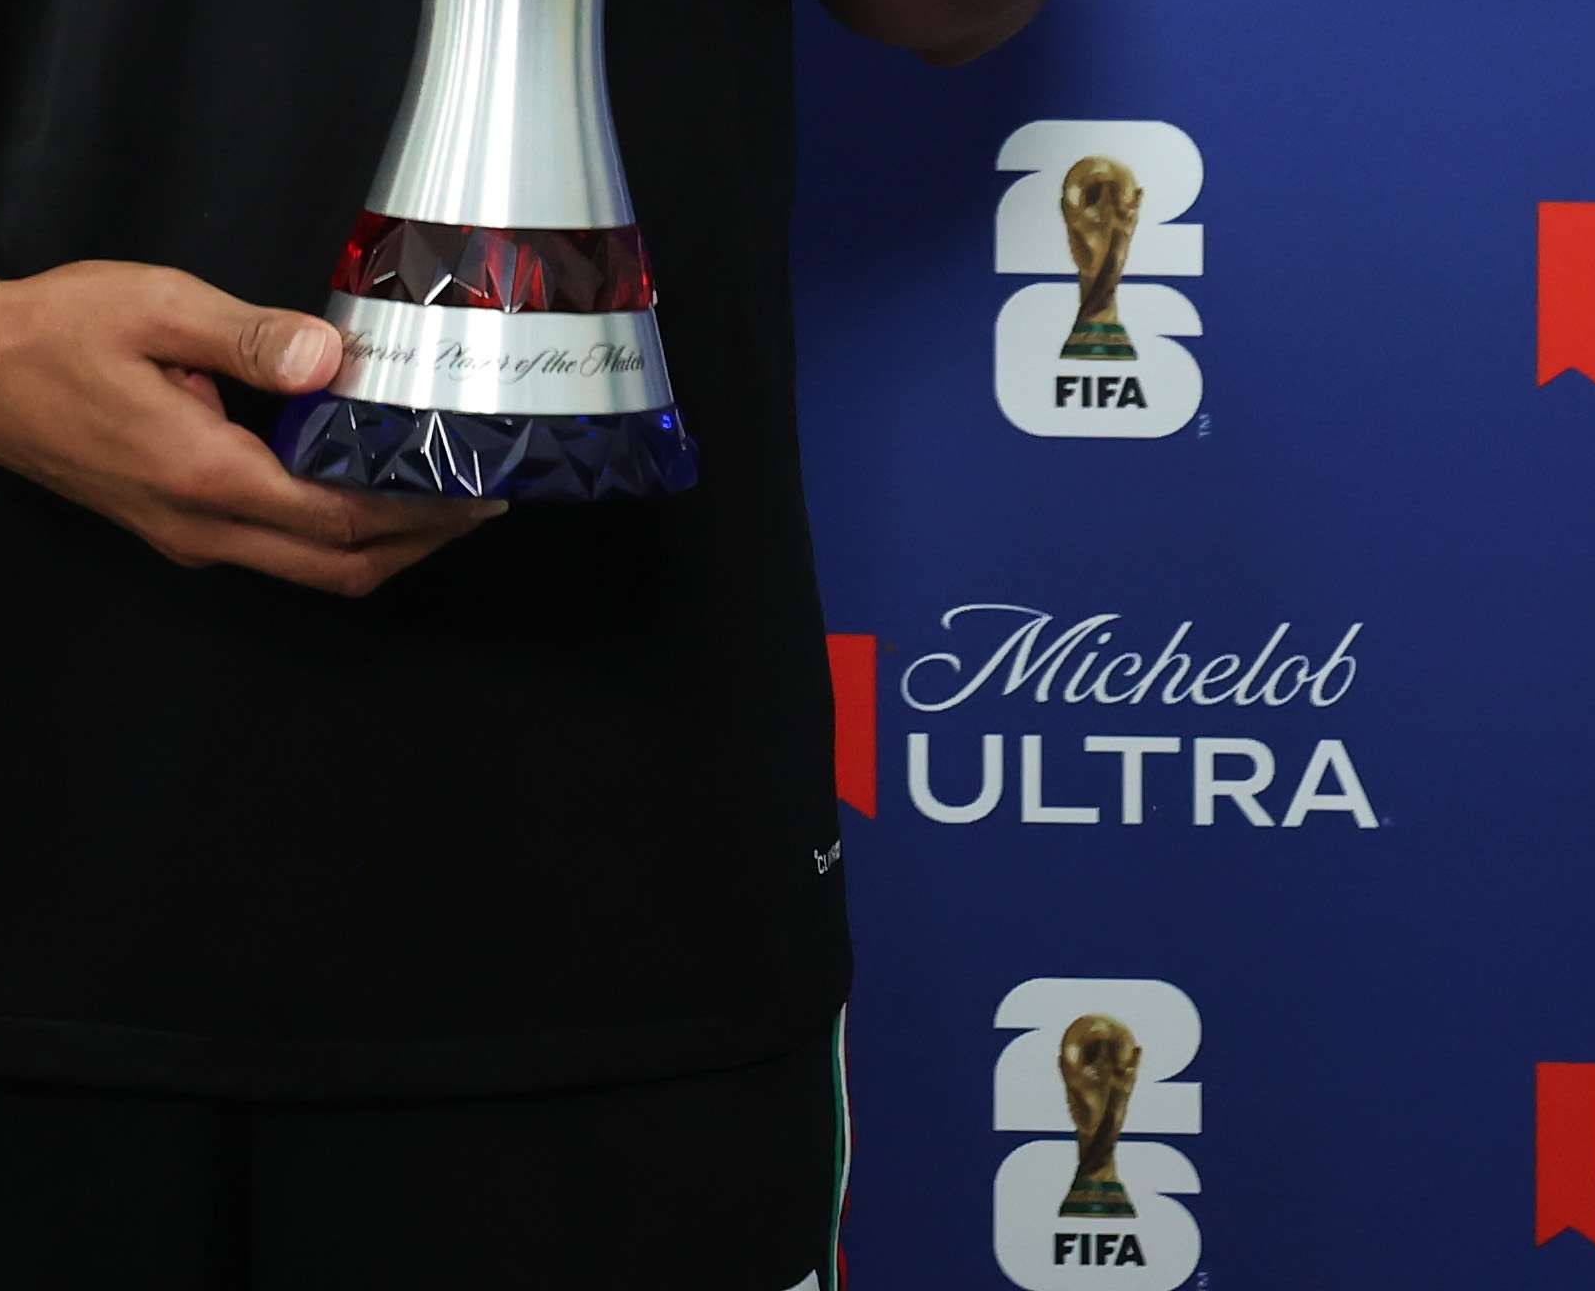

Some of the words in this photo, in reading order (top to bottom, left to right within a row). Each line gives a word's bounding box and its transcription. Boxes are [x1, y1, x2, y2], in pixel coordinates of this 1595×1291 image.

[1056, 376, 1146, 408] FIFA
[902, 604, 1363, 711] Michelob
[908, 733, 1379, 828] ULTRA
[1055, 1233, 1145, 1266] FIFA
